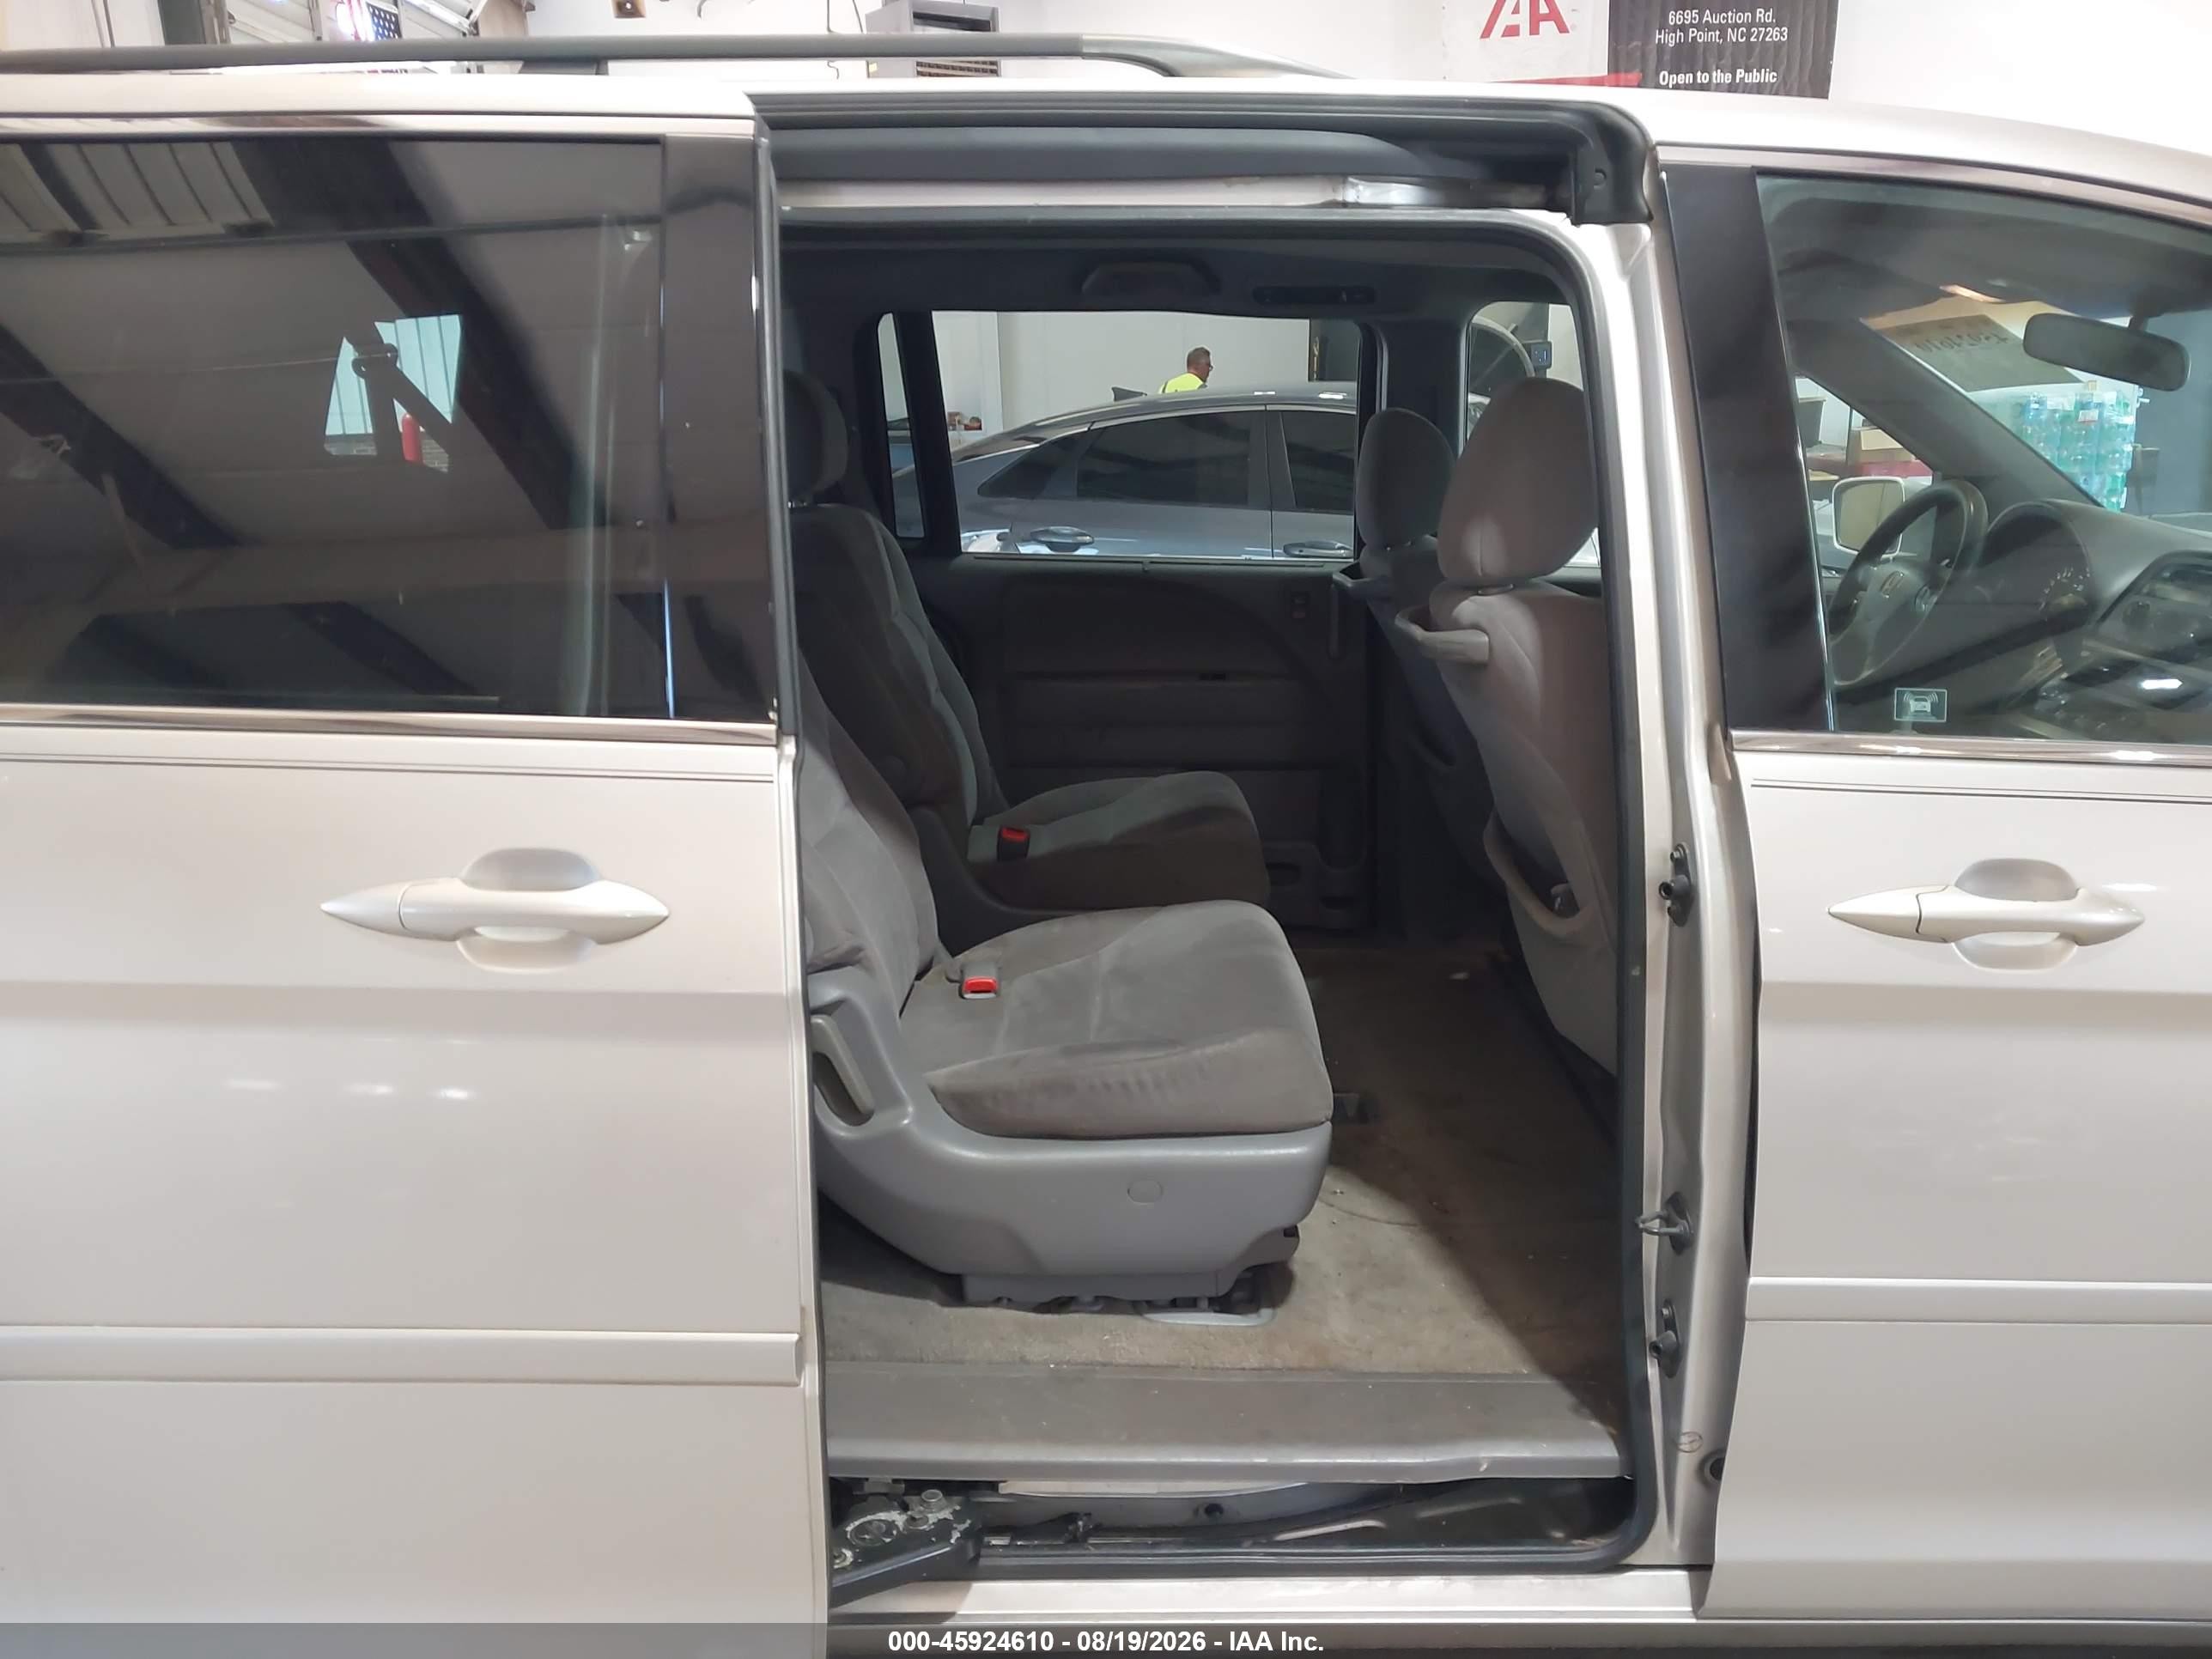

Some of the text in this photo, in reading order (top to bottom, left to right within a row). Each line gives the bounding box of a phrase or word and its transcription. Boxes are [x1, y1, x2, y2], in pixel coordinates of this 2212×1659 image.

[1668, 8, 1776, 26] 6695 Auction Rd.
[1655, 27, 1789, 47] High Point, NC 27263
[1658, 69, 1778, 88] Open to the Public
